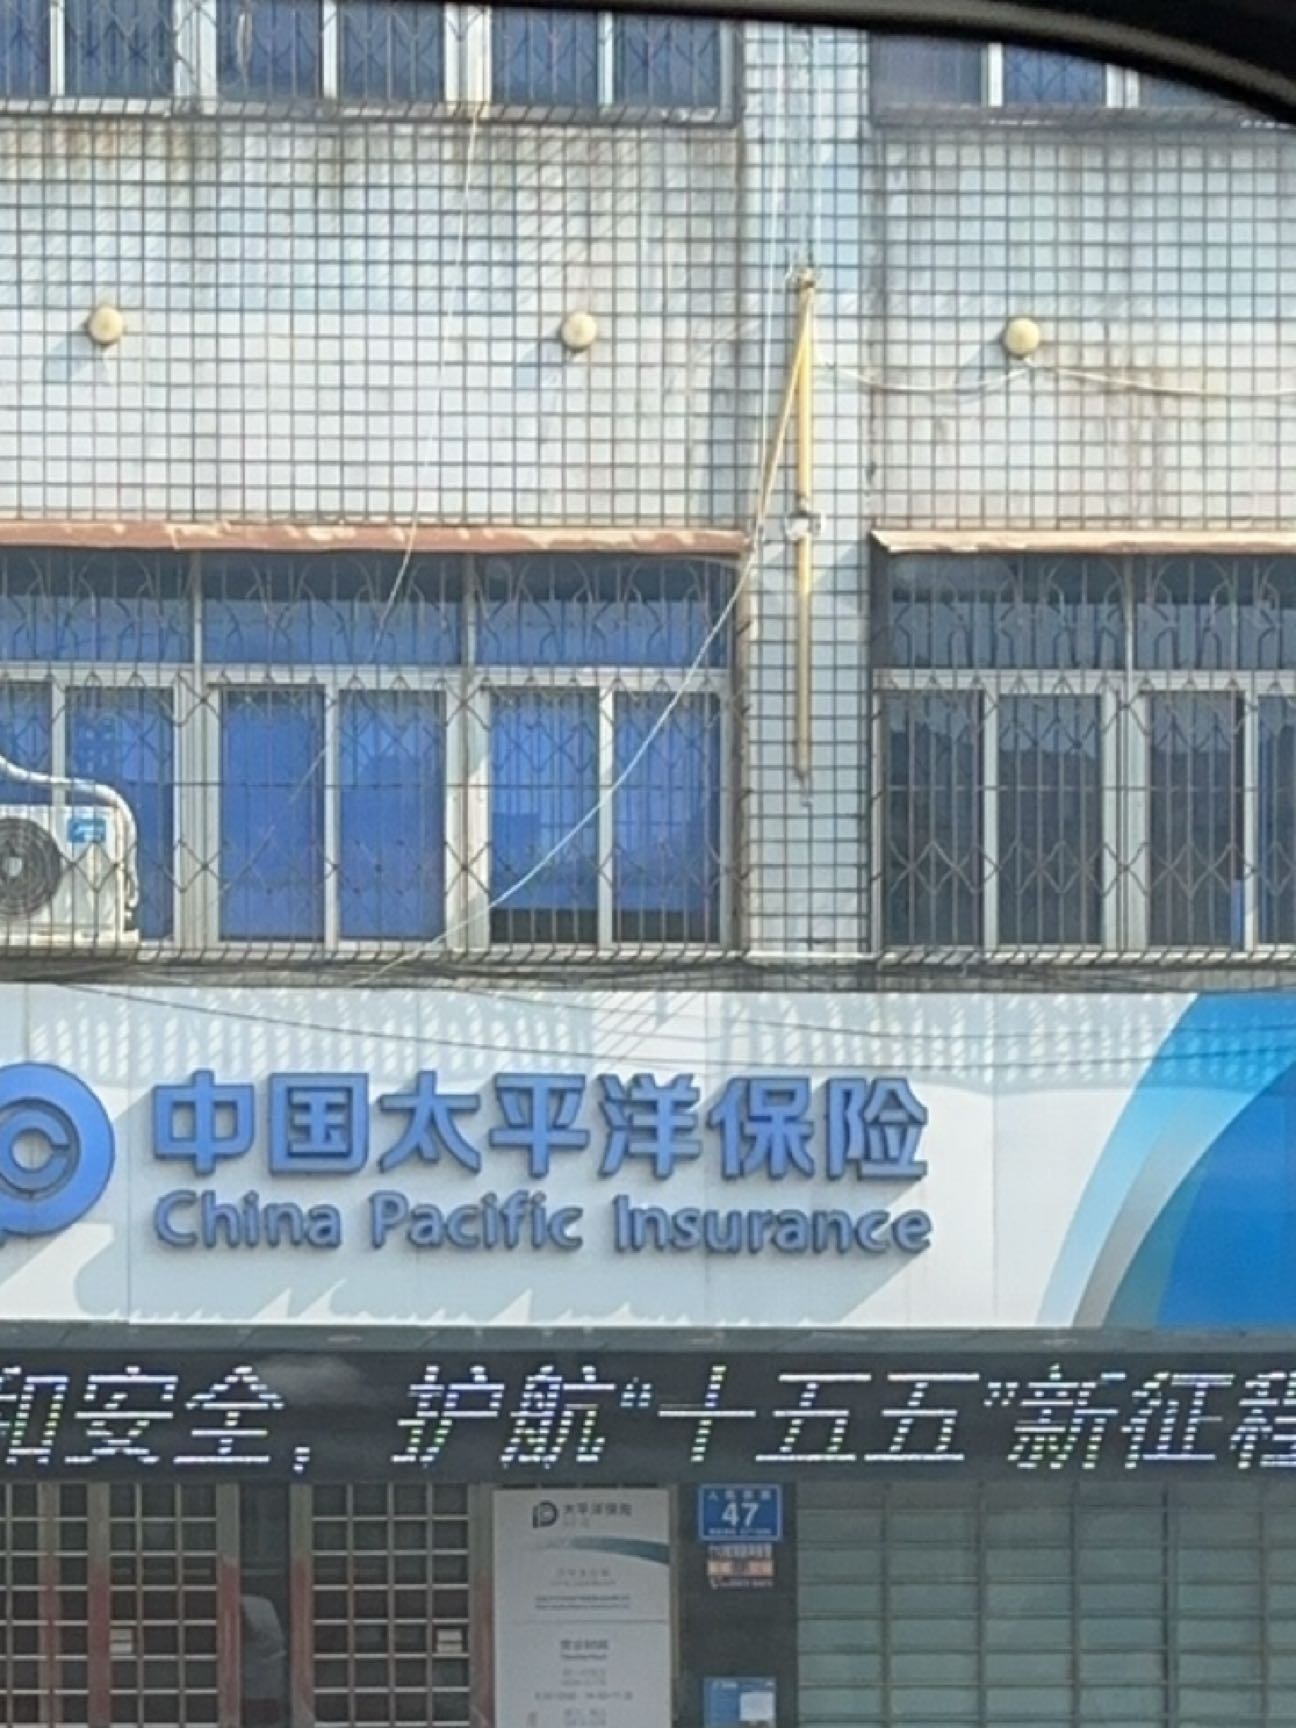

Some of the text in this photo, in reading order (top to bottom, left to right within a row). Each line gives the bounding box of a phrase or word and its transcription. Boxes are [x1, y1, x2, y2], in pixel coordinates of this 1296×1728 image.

[151, 1069, 930, 1182] 中国太平洋保险
[154, 1189, 934, 1258] China Pacific Insurance
[720, 1502, 760, 1528] 47
